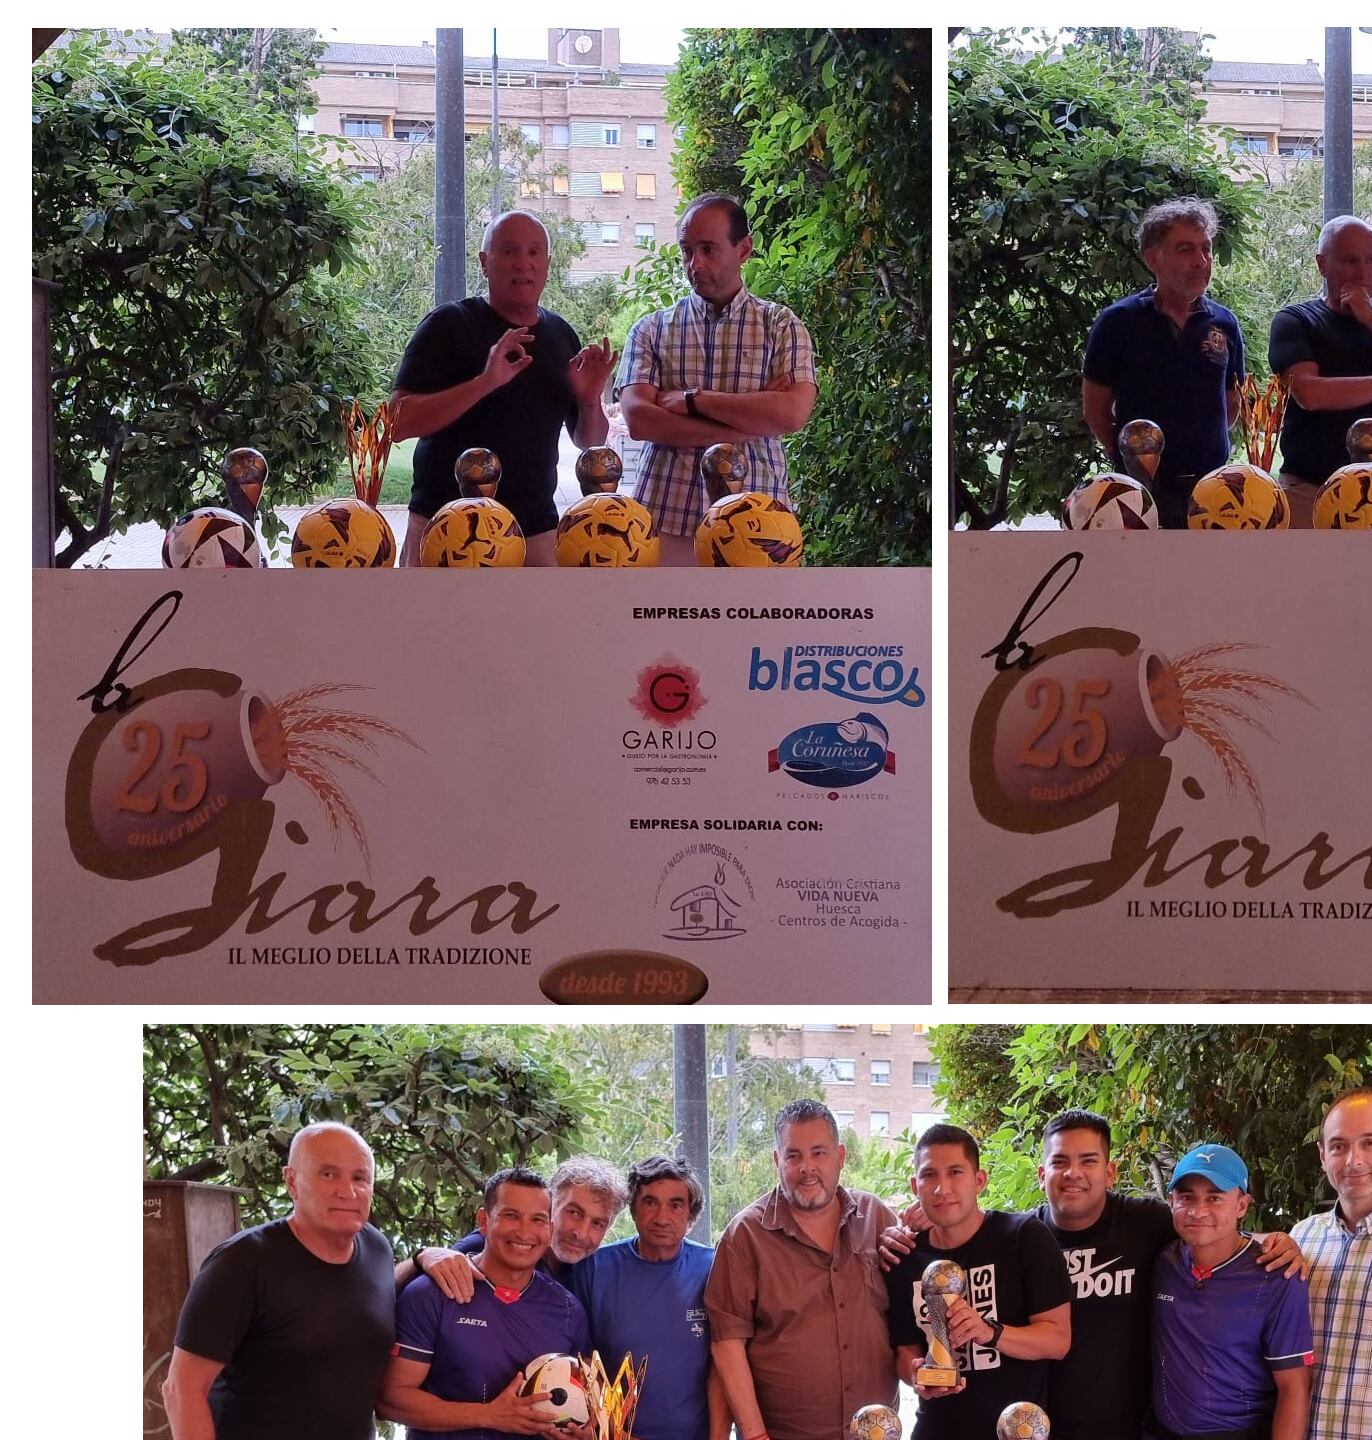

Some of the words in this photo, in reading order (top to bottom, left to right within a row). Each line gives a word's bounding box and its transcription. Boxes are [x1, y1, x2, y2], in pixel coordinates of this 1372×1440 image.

[632, 607, 721, 620] EMPRESAS
[726, 607, 874, 620] COLABORADORAS
[794, 645, 904, 657] DISTRIBUCIONES
[748, 646, 905, 697] blasco
[1018, 677, 1112, 769] 25
[622, 730, 717, 750] GARIJO
[806, 730, 824, 745] La
[791, 738, 871, 758] Coruñesa
[115, 720, 212, 814] 25
[128, 793, 227, 847] aniversario
[629, 818, 699, 831] EMPRESA
[703, 819, 783, 832] SOLIDARIA
[787, 820, 824, 832] CON:
[797, 890, 830, 902] VIDA
[833, 890, 879, 902] NUEVA
[816, 902, 861, 915] Huesca
[1126, 899, 1145, 918] IL
[1149, 900, 1228, 919] MEGLIO
[1232, 901, 1295, 920] DELLA
[778, 914, 826, 928] Centros
[830, 914, 846, 927] de
[850, 915, 900, 930] Acogida
[228, 947, 248, 966] IL
[252, 947, 333, 966] MEGLIO
[337, 947, 401, 967] DELLA
[405, 947, 532, 967] TRADIZIONE
[559, 967, 625, 996] desde
[633, 969, 689, 996] 1993
[456, 1317, 488, 1328] SAETA
